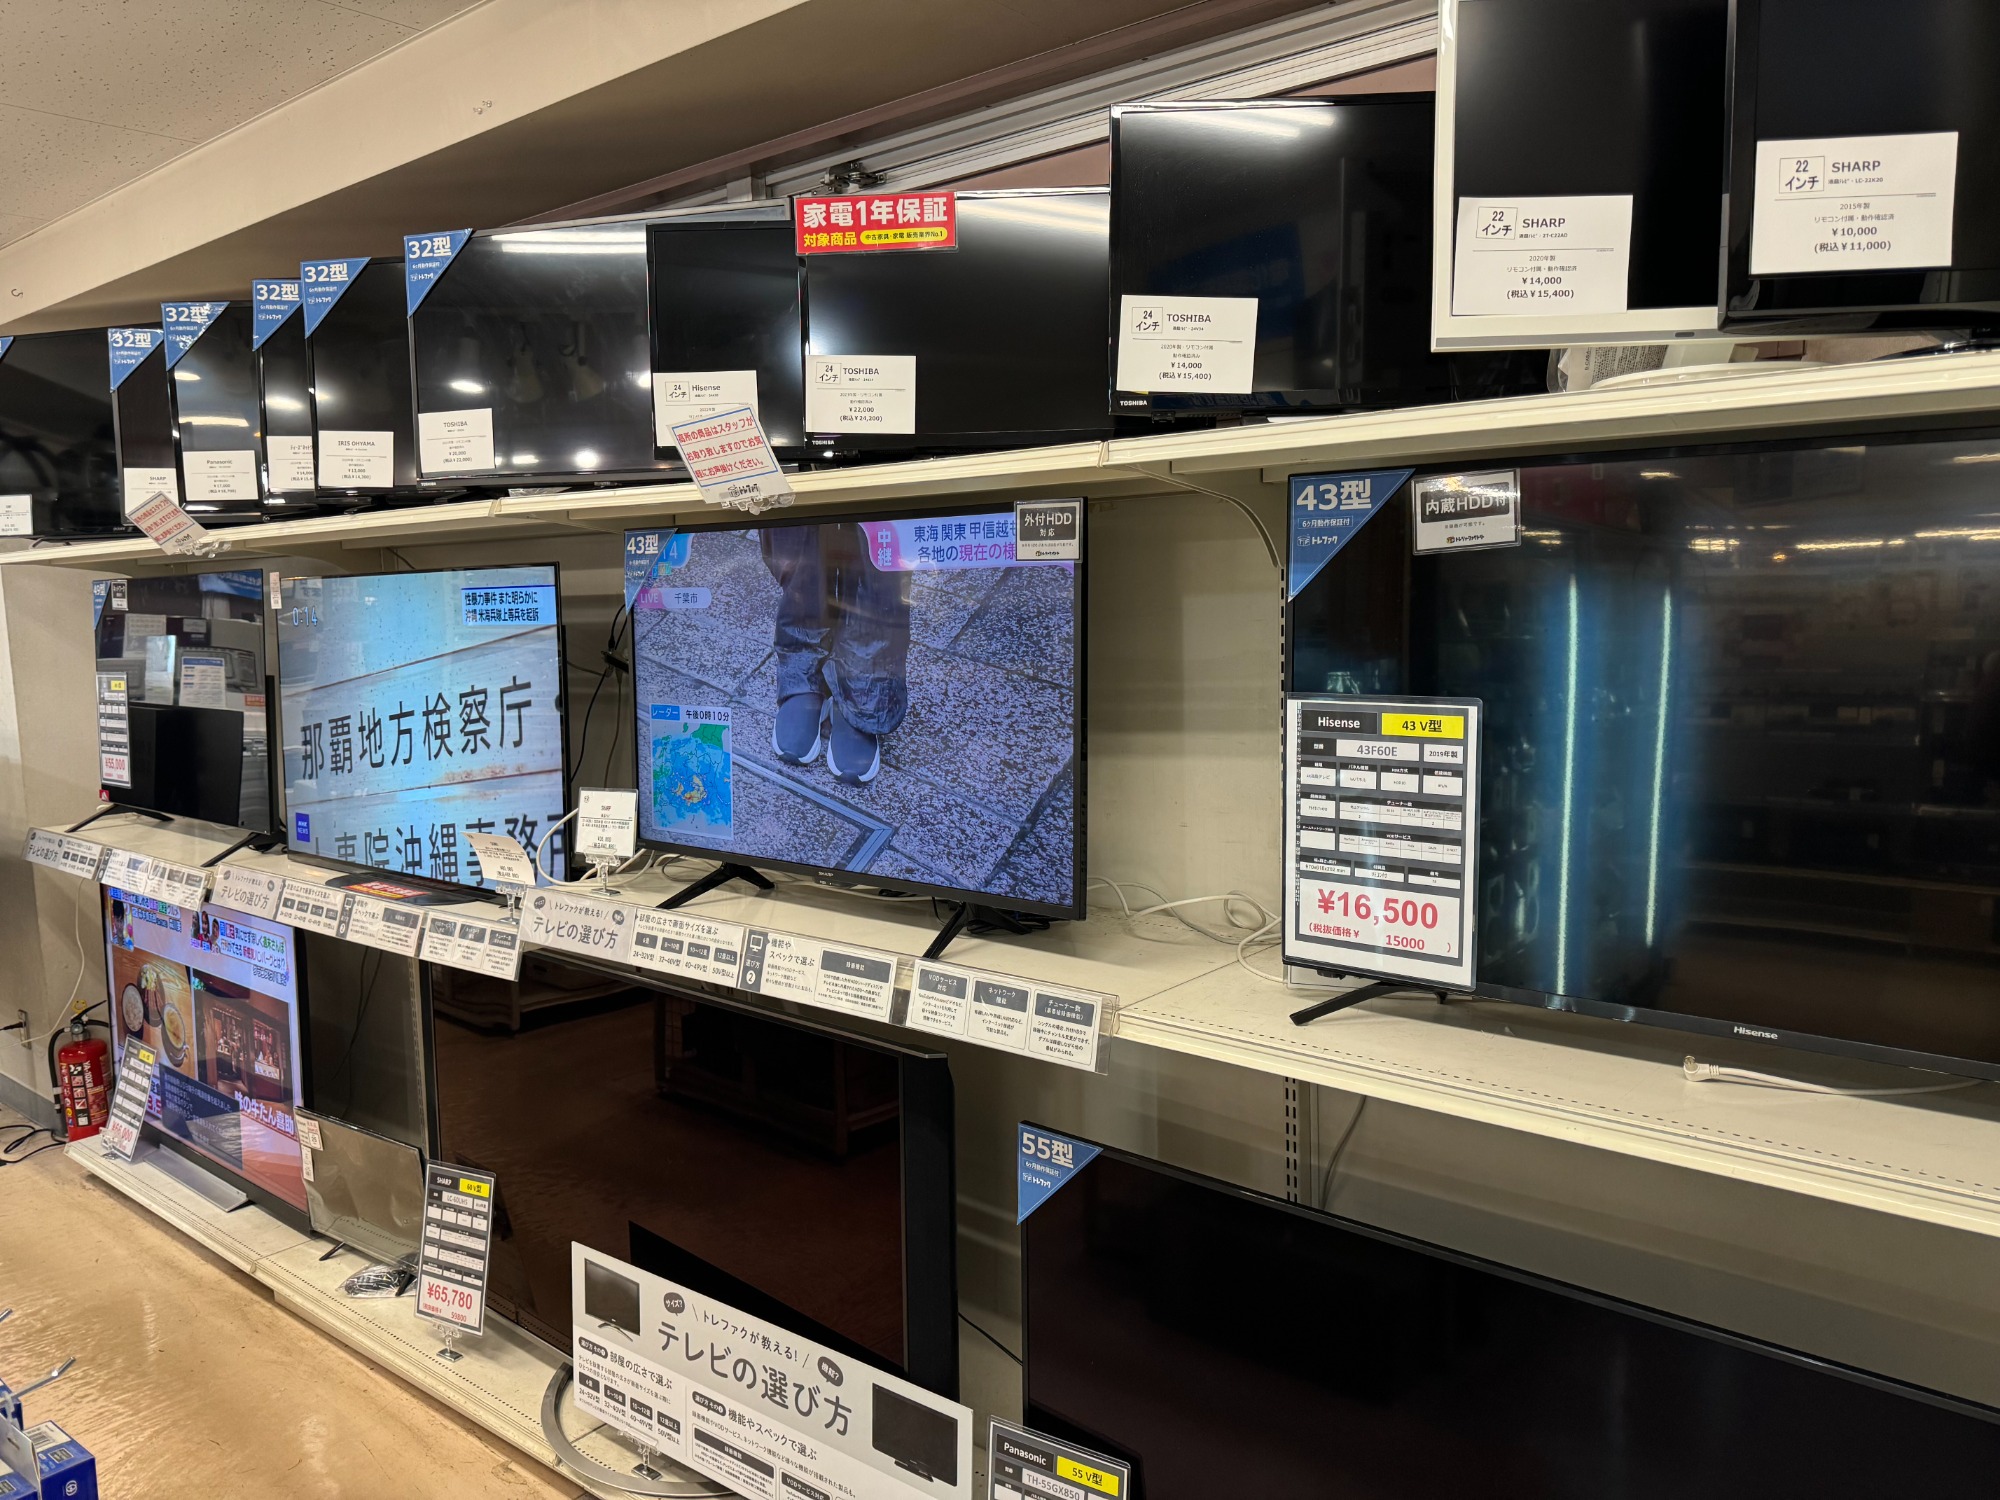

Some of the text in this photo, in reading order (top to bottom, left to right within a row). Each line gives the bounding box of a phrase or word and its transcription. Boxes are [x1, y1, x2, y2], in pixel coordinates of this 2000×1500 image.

[1796, 160, 1809, 173] 22
[1831, 160, 1881, 173] SHARP
[1785, 175, 1819, 191] インチ
[803, 197, 948, 229] 家電1年保証
[1840, 202, 1870, 210] 2015年製
[1492, 210, 1504, 222] 22
[1522, 218, 1566, 229] SHARP
[1482, 224, 1512, 236] インチ
[1832, 227, 1878, 237] ¥10,000
[408, 235, 452, 258] 32型
[803, 232, 857, 247] 対象商品
[1814, 241, 1891, 254] (税込¥11,000)
[304, 262, 349, 283] 32型
[1522, 276, 1562, 286] ¥14,000
[256, 283, 300, 301] 32型
[1507, 289, 1575, 299] (税込¥15,400)
[165, 306, 209, 322] 32型
[1143, 310, 1153, 319] 24
[1167, 313, 1211, 323] TOSHIBA
[1135, 321, 1159, 332] インチ
[112, 332, 152, 348] 32型
[819, 374, 839, 382] インチ
[843, 367, 879, 375] TOSHIBA
[1159, 372, 1212, 380] (税込¥15,400)
[443, 420, 468, 429] TOSHIBA
[676, 416, 754, 443] 高所の商品はスタッフが
[686, 435, 764, 461] お取り致しますのでお気
[1296, 478, 1372, 511] 43型
[1425, 494, 1506, 515] 内蔵HDD付
[1024, 512, 1072, 527] 外付HDD
[914, 524, 939, 543] 東海
[942, 522, 967, 541] 関東
[1039, 528, 1055, 537] 対応
[1311, 535, 1338, 545] トレファク
[626, 533, 659, 555] 43型
[877, 528, 892, 566] 中継
[465, 591, 538, 606] 性暴力事件 また明らかに
[640, 593, 698, 604] LIVE 千葉市
[652, 708, 729, 721] レーダー 午後0時10分
[300, 675, 532, 780] 那覇地方検察庁
[1317, 716, 1443, 733] Hisense 43 V型
[1356, 744, 1398, 757] 43F60E
[1428, 749, 1458, 759] 2019年製
[220, 885, 270, 909] テレビの選び方
[1317, 888, 1438, 929] ¥16,500
[639, 913, 719, 935] 部屋の広さで画面サイズを選ぶ
[533, 917, 619, 950] テレビの選び方
[1385, 934, 1425, 951] 15000
[768, 950, 815, 967] スペックで選ぶ
[988, 986, 1016, 998] ネットワーク
[1048, 999, 1081, 1013] チューナー数
[1734, 1026, 1778, 1039] Hisense
[1022, 1132, 1074, 1168] 55型
[436, 1176, 453, 1186] SHARP
[427, 1281, 473, 1310] ¥65,780
[665, 1299, 683, 1309] サイズ?
[451, 1311, 467, 1322] 59800
[703, 1309, 798, 1362] トレファクが教える!
[609, 1351, 673, 1389] 部屋の広さで選ぶ
[821, 1362, 839, 1381] 機能?
[657, 1321, 852, 1437] テレビの選び方
[728, 1407, 817, 1461] 機能やスペックで選ぶ
[1004, 1442, 1103, 1486] Panasonic 55 V型
[1027, 1473, 1080, 1500] TH-55GX850
